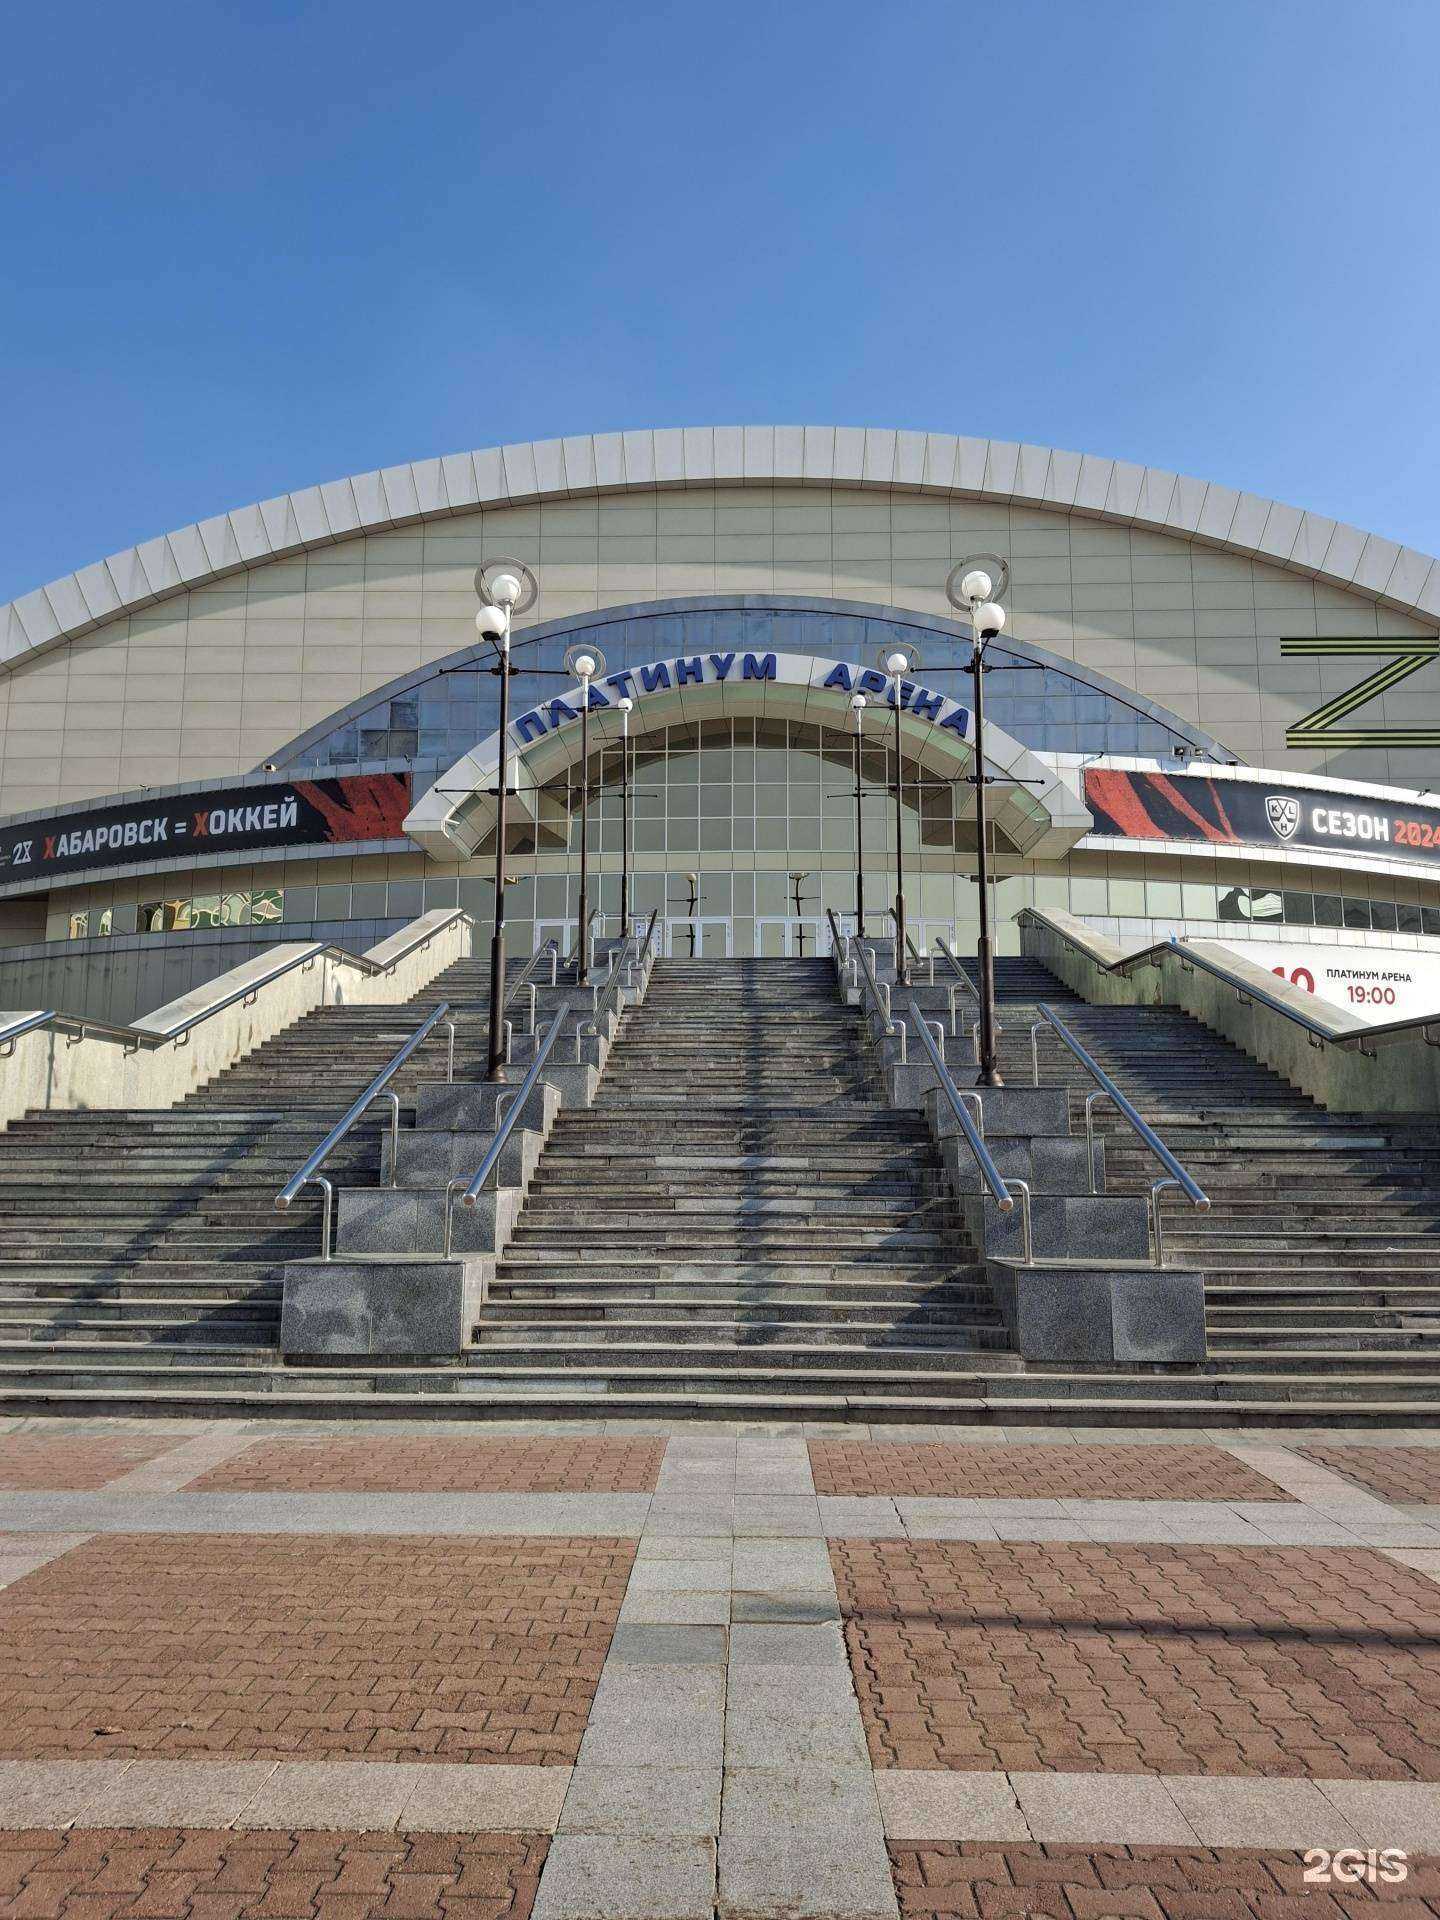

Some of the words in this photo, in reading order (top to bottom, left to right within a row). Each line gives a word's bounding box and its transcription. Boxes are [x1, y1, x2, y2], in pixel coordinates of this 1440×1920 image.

[515, 653, 777, 743] ПЛАТИНУМ
[824, 663, 969, 738] АРЕНА
[42, 817, 168, 860] ХАБАРОВСК
[192, 796, 298, 837] ХОККЕЙ
[1312, 808, 1389, 841] СЕЗОН
[1326, 969, 1379, 981] ПЛАТИНУМ
[1381, 972, 1412, 983] АРЕНА
[1347, 985, 1396, 1005] 19:00
